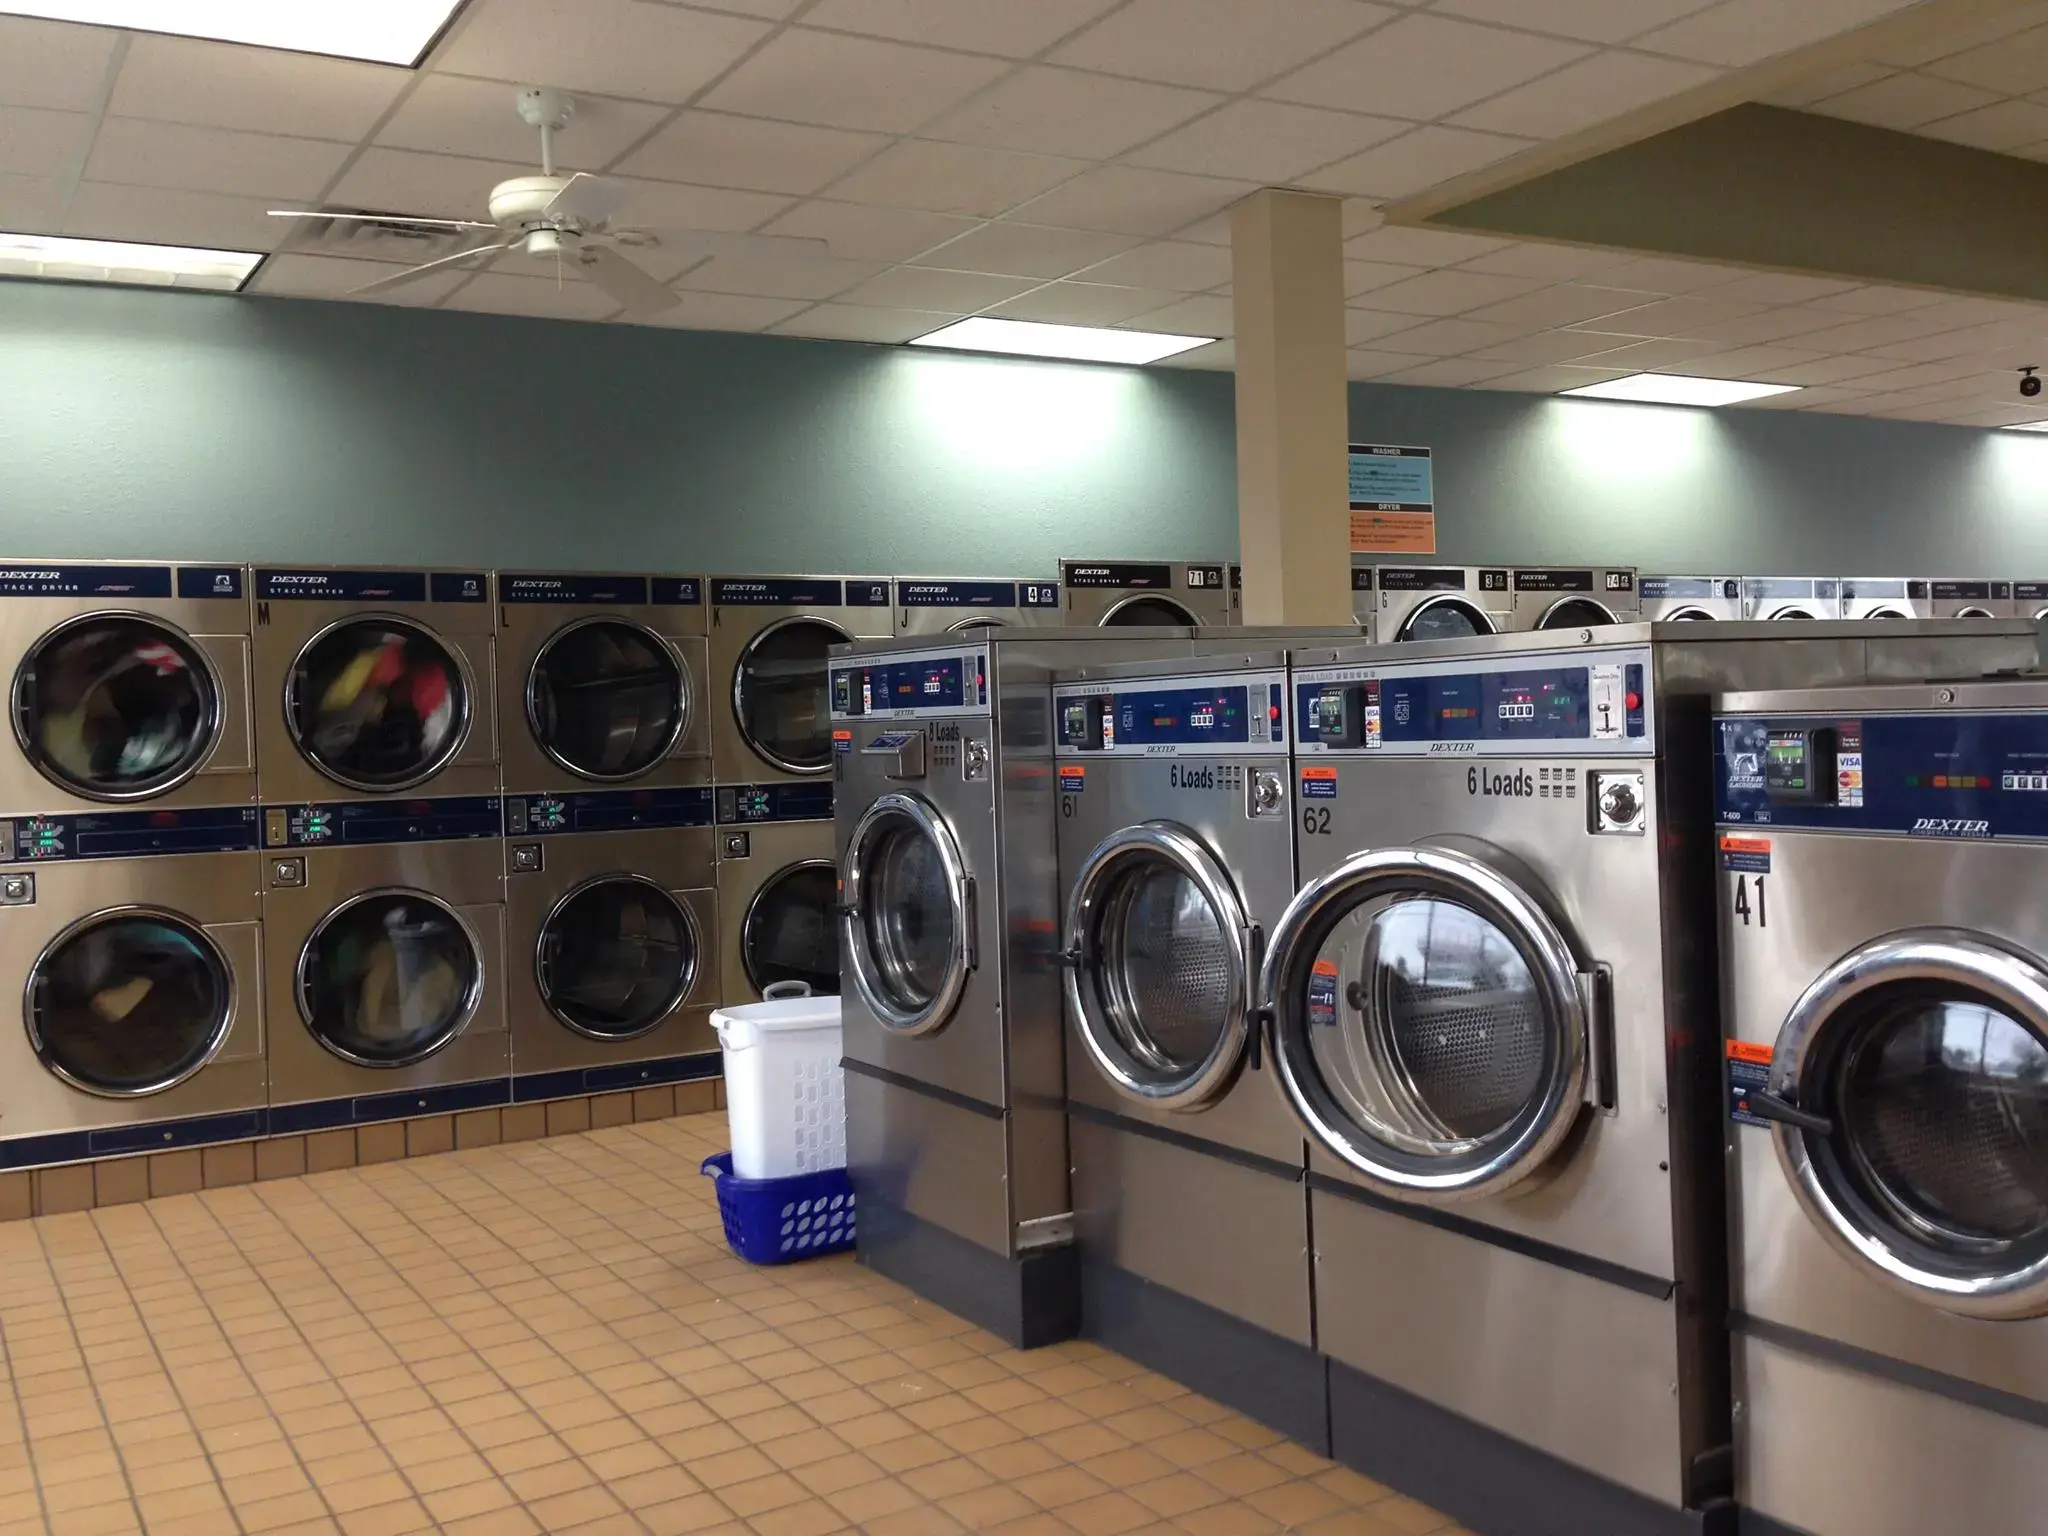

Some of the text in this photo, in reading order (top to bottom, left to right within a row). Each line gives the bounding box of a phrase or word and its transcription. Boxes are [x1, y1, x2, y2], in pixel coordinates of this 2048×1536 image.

[0, 571, 60, 580] DEXTER
[270, 576, 328, 584] DEXTER
[1029, 588, 1036, 601] 4
[258, 603, 270, 625] M
[502, 607, 509, 627] L
[714, 608, 721, 628] K
[901, 609, 908, 628] J
[929, 722, 960, 742] 8 Loads
[1146, 745, 1176, 753] DEXTER
[1430, 743, 1474, 752] DEXTER
[1840, 758, 1860, 766] VISA
[1170, 764, 1214, 789] 6 Loads
[1468, 767, 1533, 797] 6 Loads
[1062, 795, 1078, 819] 61
[1303, 806, 1331, 835] 62
[1913, 819, 1989, 831] DEXTER
[1735, 874, 1766, 927] 41
